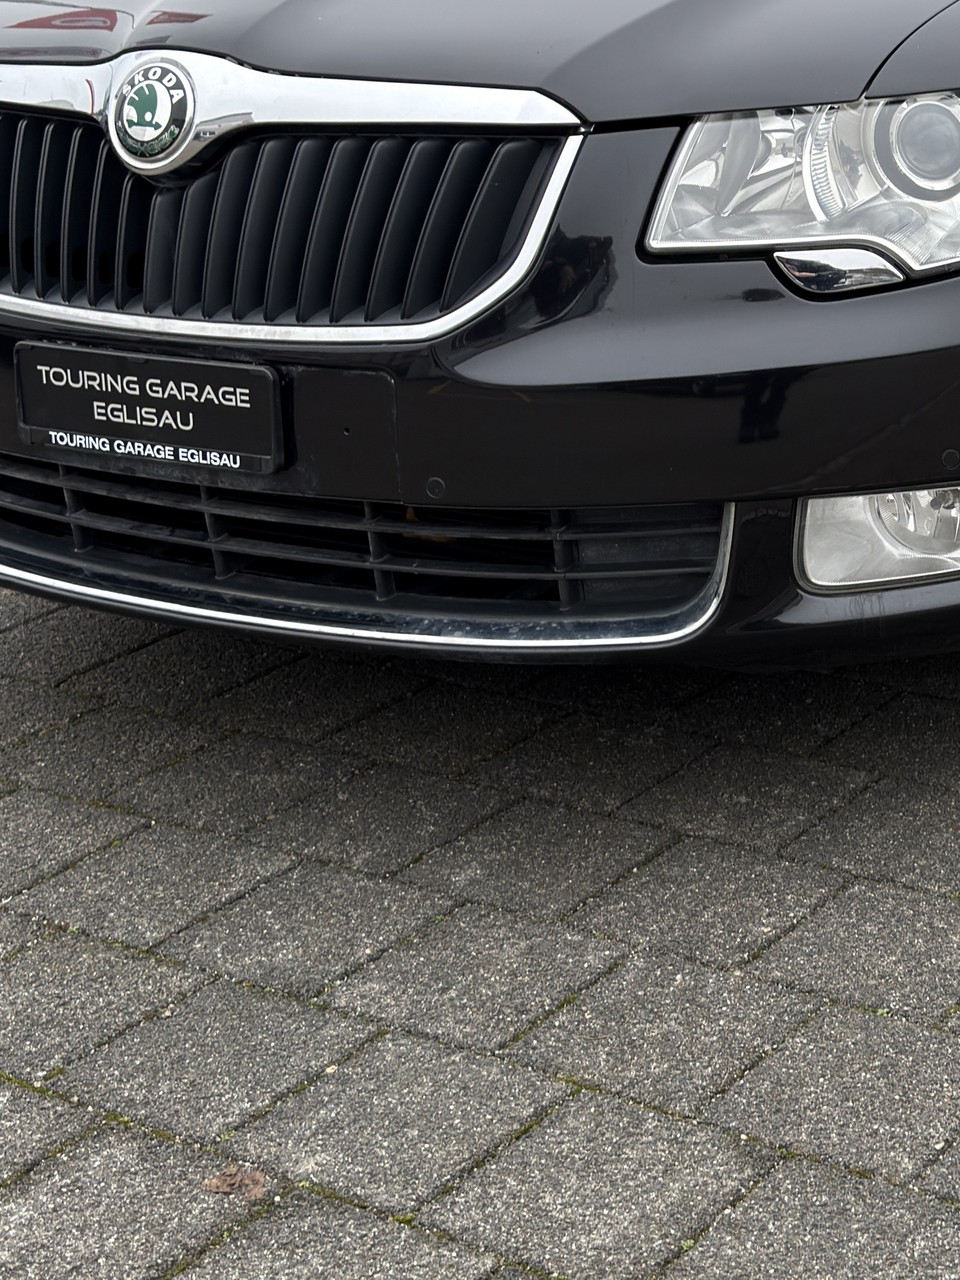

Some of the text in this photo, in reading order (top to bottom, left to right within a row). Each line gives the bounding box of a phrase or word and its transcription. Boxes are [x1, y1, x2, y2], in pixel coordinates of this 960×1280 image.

[36, 365, 251, 408] TOURING GARAGE
[93, 401, 194, 431] EGLISAU
[49, 431, 241, 469] TOURING GARAGE EGLISAU
